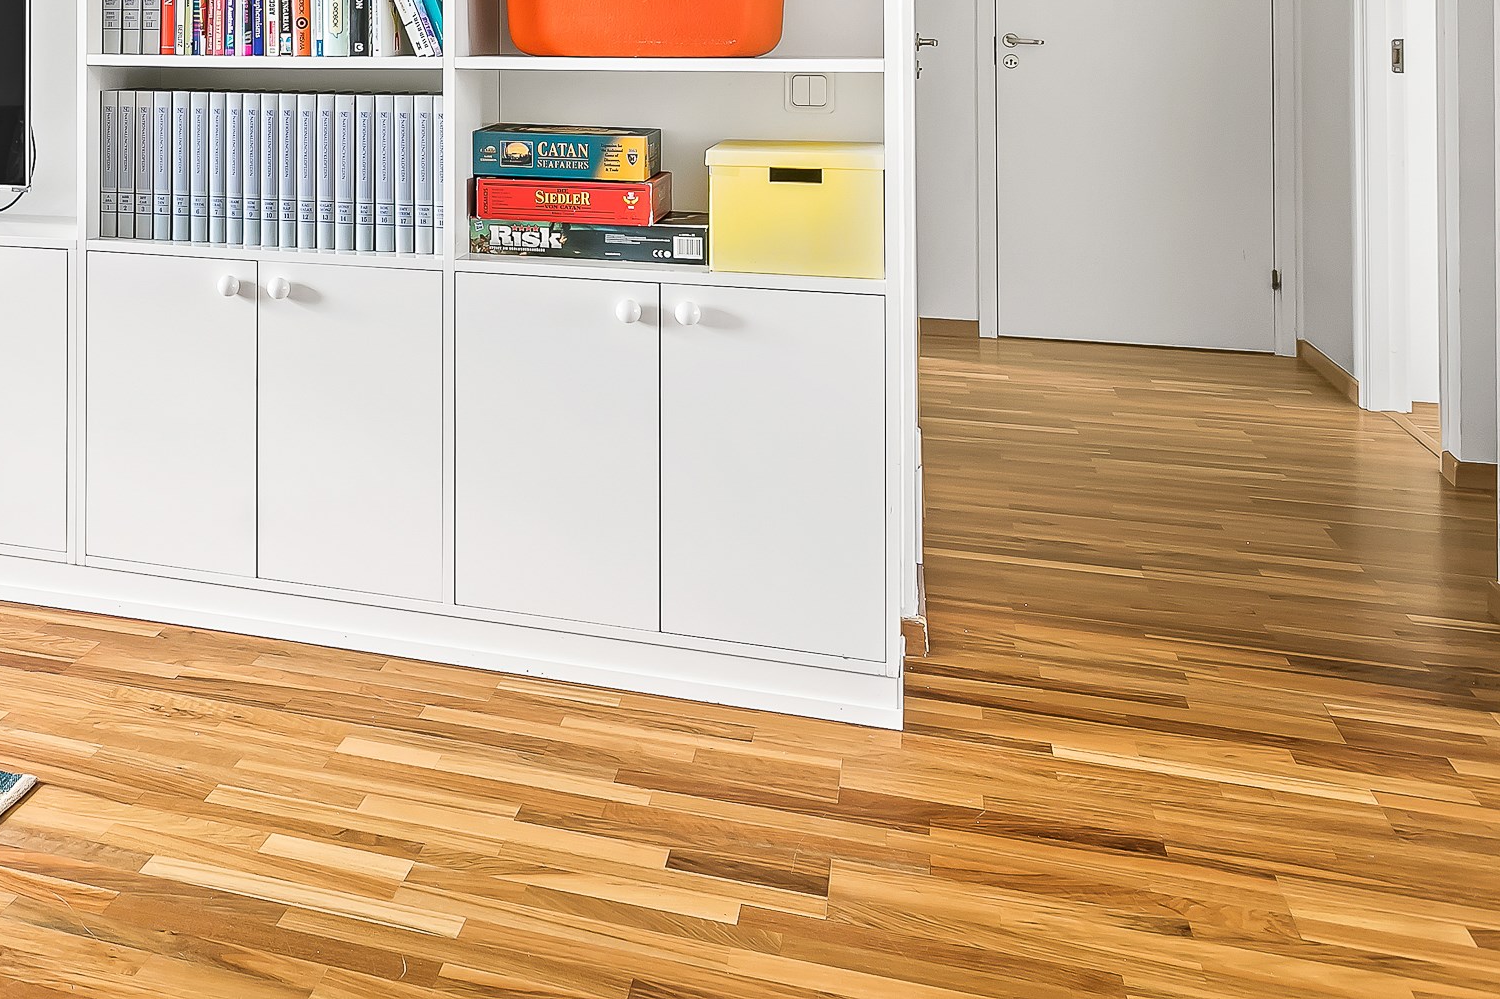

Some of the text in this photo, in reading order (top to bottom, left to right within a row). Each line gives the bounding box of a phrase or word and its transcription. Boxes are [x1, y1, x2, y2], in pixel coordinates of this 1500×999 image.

[537, 142, 589, 158] CATAN
[537, 159, 589, 169] SEAFARERS
[535, 190, 591, 205] SIEDLER
